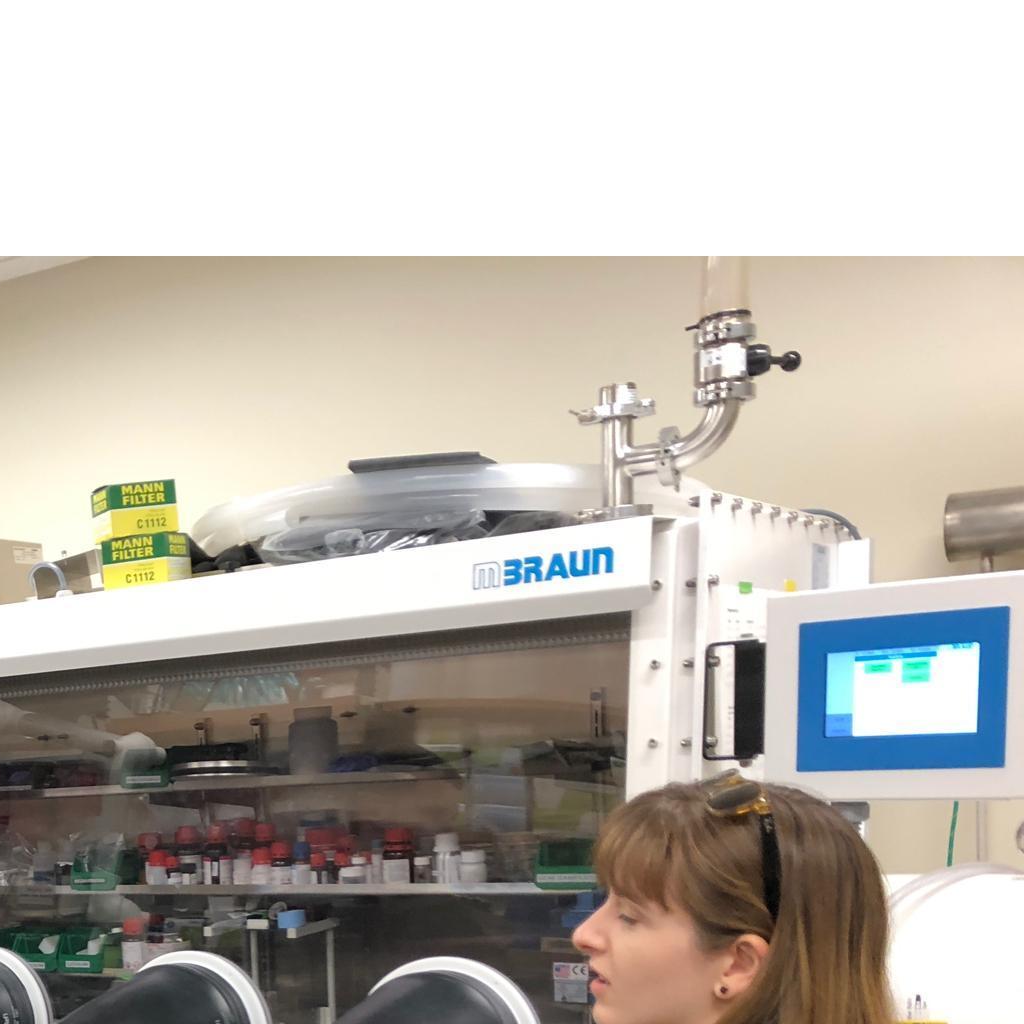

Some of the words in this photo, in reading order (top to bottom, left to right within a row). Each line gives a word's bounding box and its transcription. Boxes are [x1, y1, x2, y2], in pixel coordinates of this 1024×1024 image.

[121, 482, 164, 495] MANN
[122, 492, 165, 506] FILTER
[111, 536, 153, 550] MANN
[112, 546, 154, 561] FILTER
